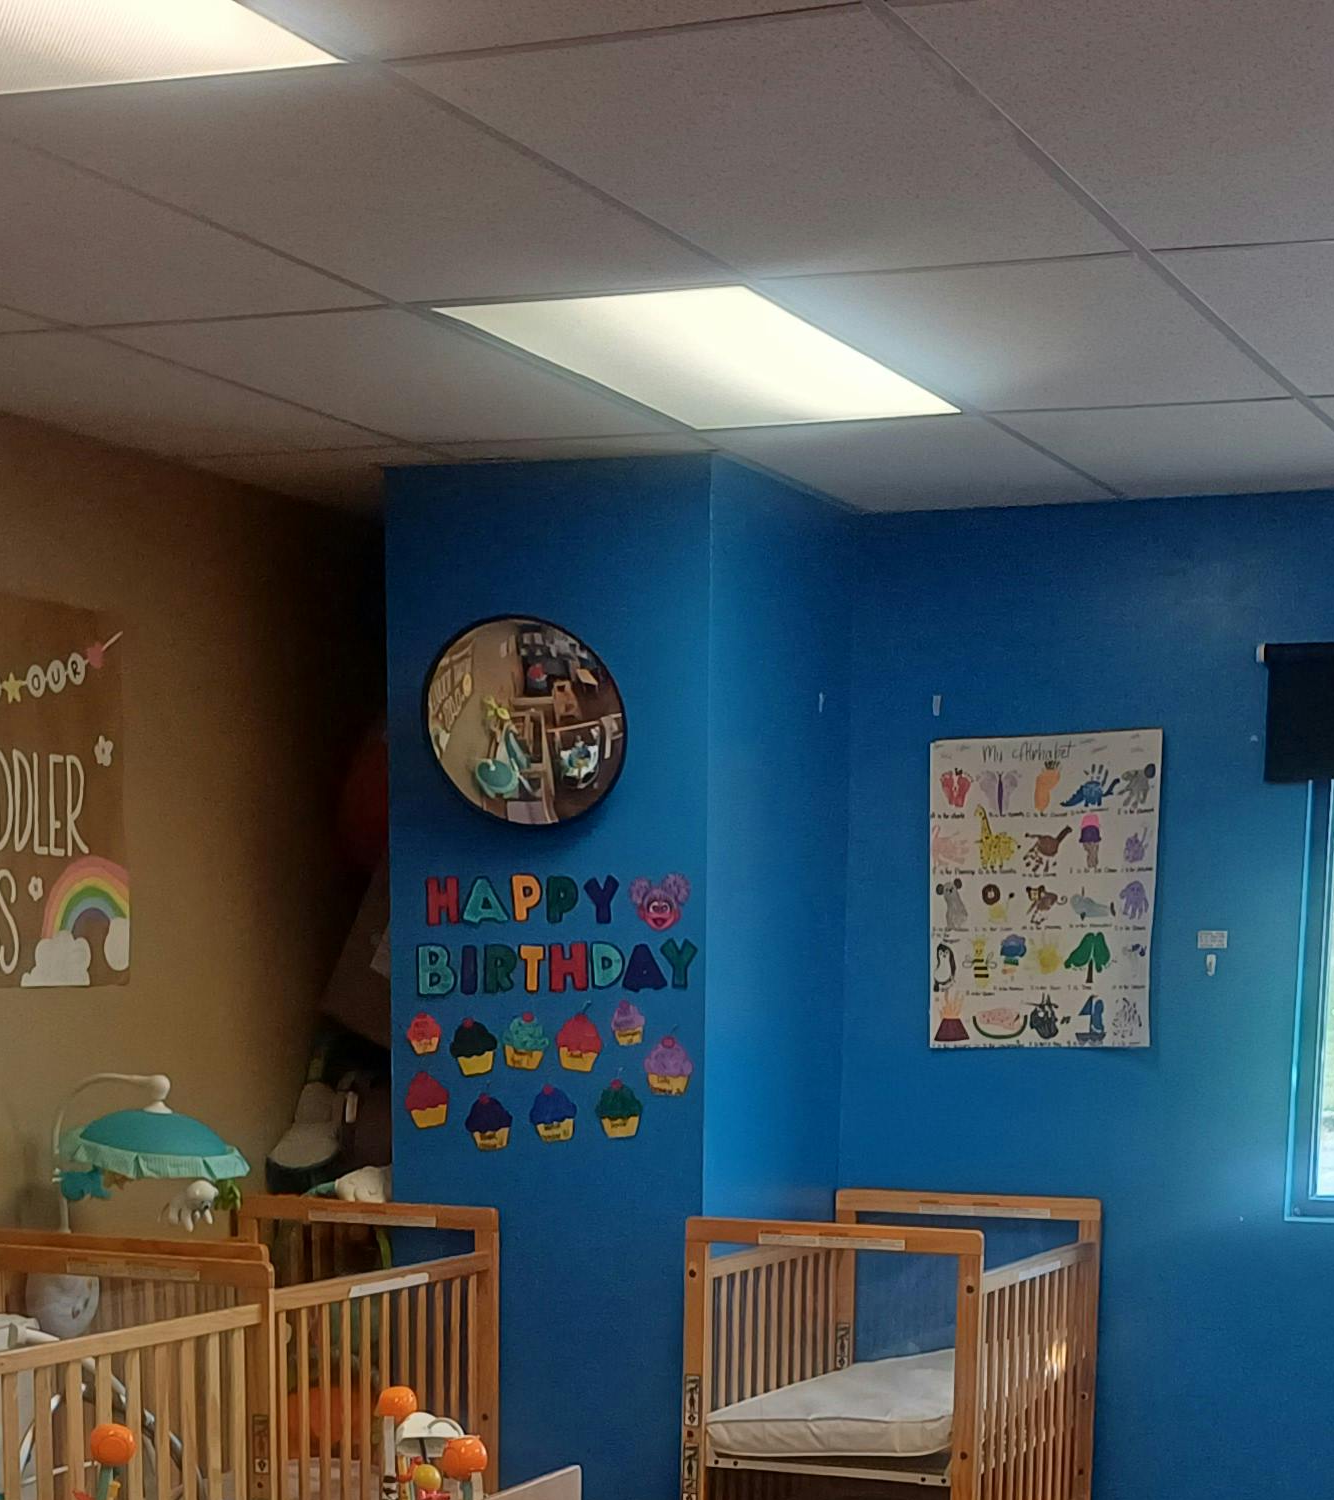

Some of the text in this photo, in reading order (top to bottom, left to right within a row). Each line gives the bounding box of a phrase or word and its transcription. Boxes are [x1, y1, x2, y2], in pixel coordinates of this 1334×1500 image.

[29, 657, 84, 688] OUR
[981, 745, 1004, 763] My
[425, 873, 620, 926] HAPPY
[417, 937, 698, 997] BIRTHDAY
